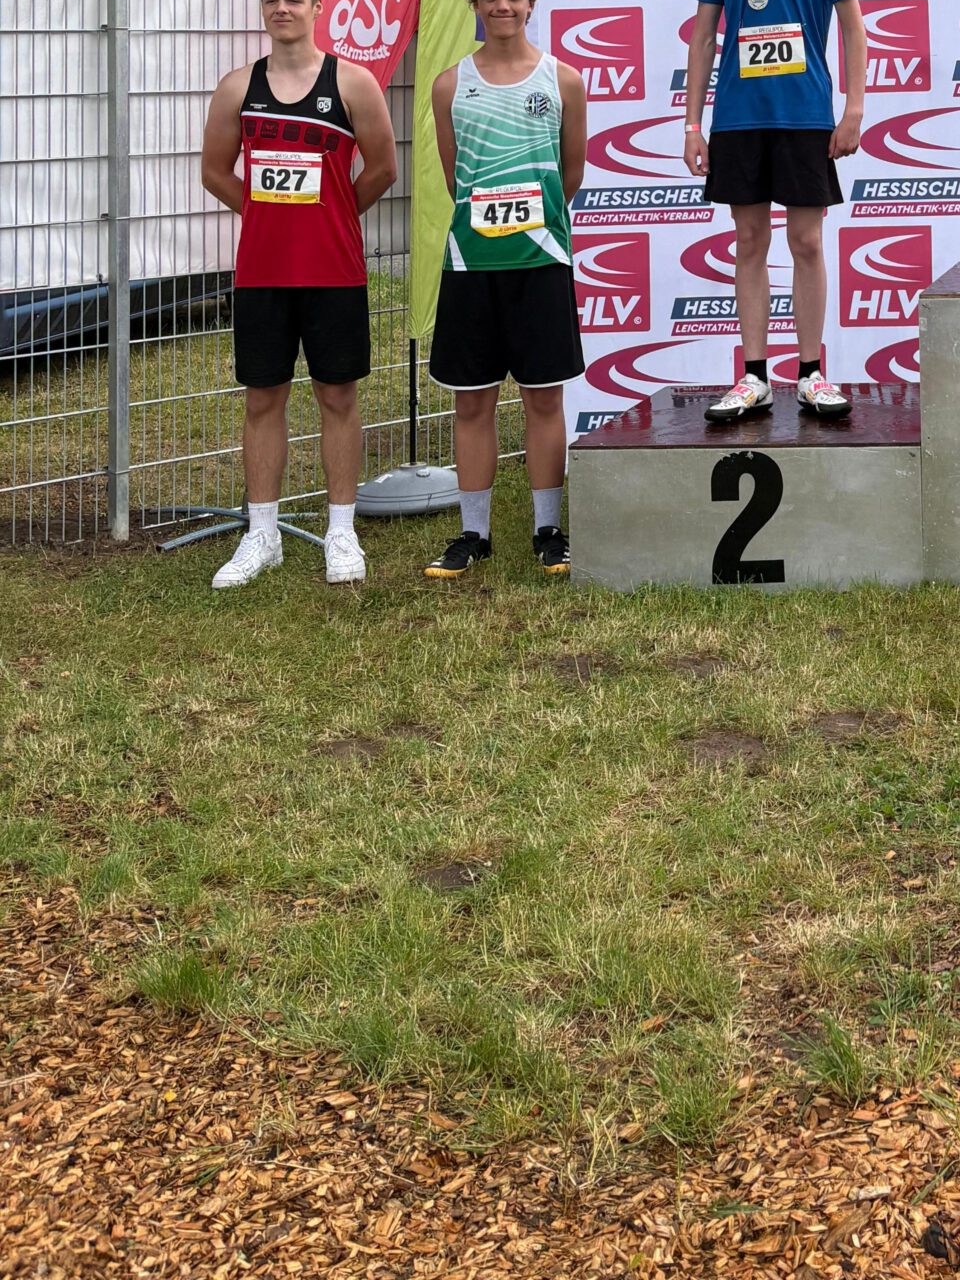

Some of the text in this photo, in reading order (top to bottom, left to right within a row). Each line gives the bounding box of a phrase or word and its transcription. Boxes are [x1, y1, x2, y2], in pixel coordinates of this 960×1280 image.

[332, 39, 391, 62] darmstadt
[748, 40, 793, 66] 220
[261, 168, 308, 192] 627
[584, 188, 702, 207] HESSISCHER
[483, 200, 530, 225] 475
[576, 212, 711, 224] LEICHTATHLETIK-VERBAND
[849, 289, 924, 320] HLV
[711, 451, 786, 585] 2
